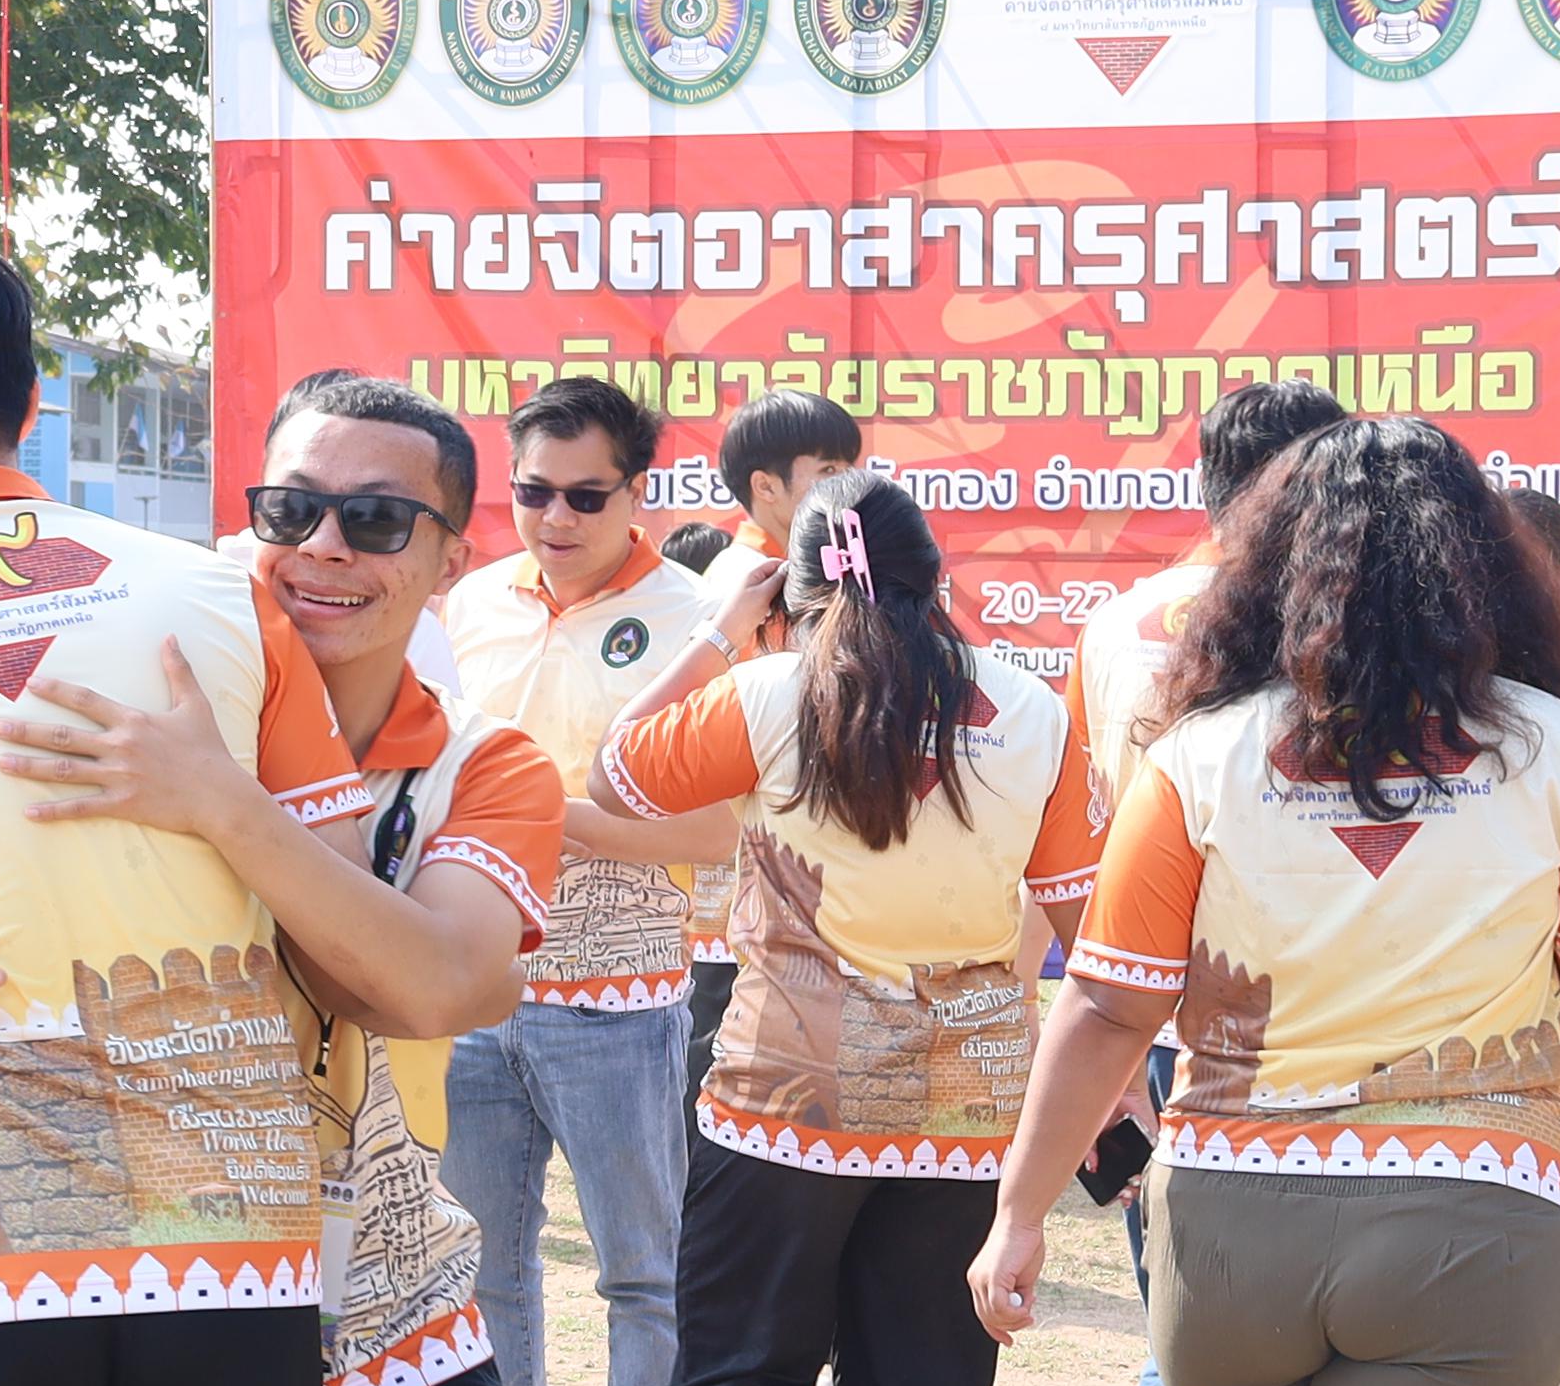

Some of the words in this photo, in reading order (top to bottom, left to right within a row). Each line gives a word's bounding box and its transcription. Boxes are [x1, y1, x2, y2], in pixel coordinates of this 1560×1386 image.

[445, 31, 468, 78] NAKHON
[467, 71, 496, 98] SAWAN
[500, 84, 543, 103] RAJABHAT
[545, 29, 580, 87] UNIVERSITY
[673, 76, 730, 102] RAJABHAT
[730, 9, 762, 77] UNIVERSITY
[797, 0, 838, 77] PHETCHABUN
[840, 68, 910, 93] RAJABHAT
[1336, 39, 1357, 64] MAI
[1361, 59, 1433, 80] RAJABHAT
[334, 76, 393, 108] RAJABHAT
